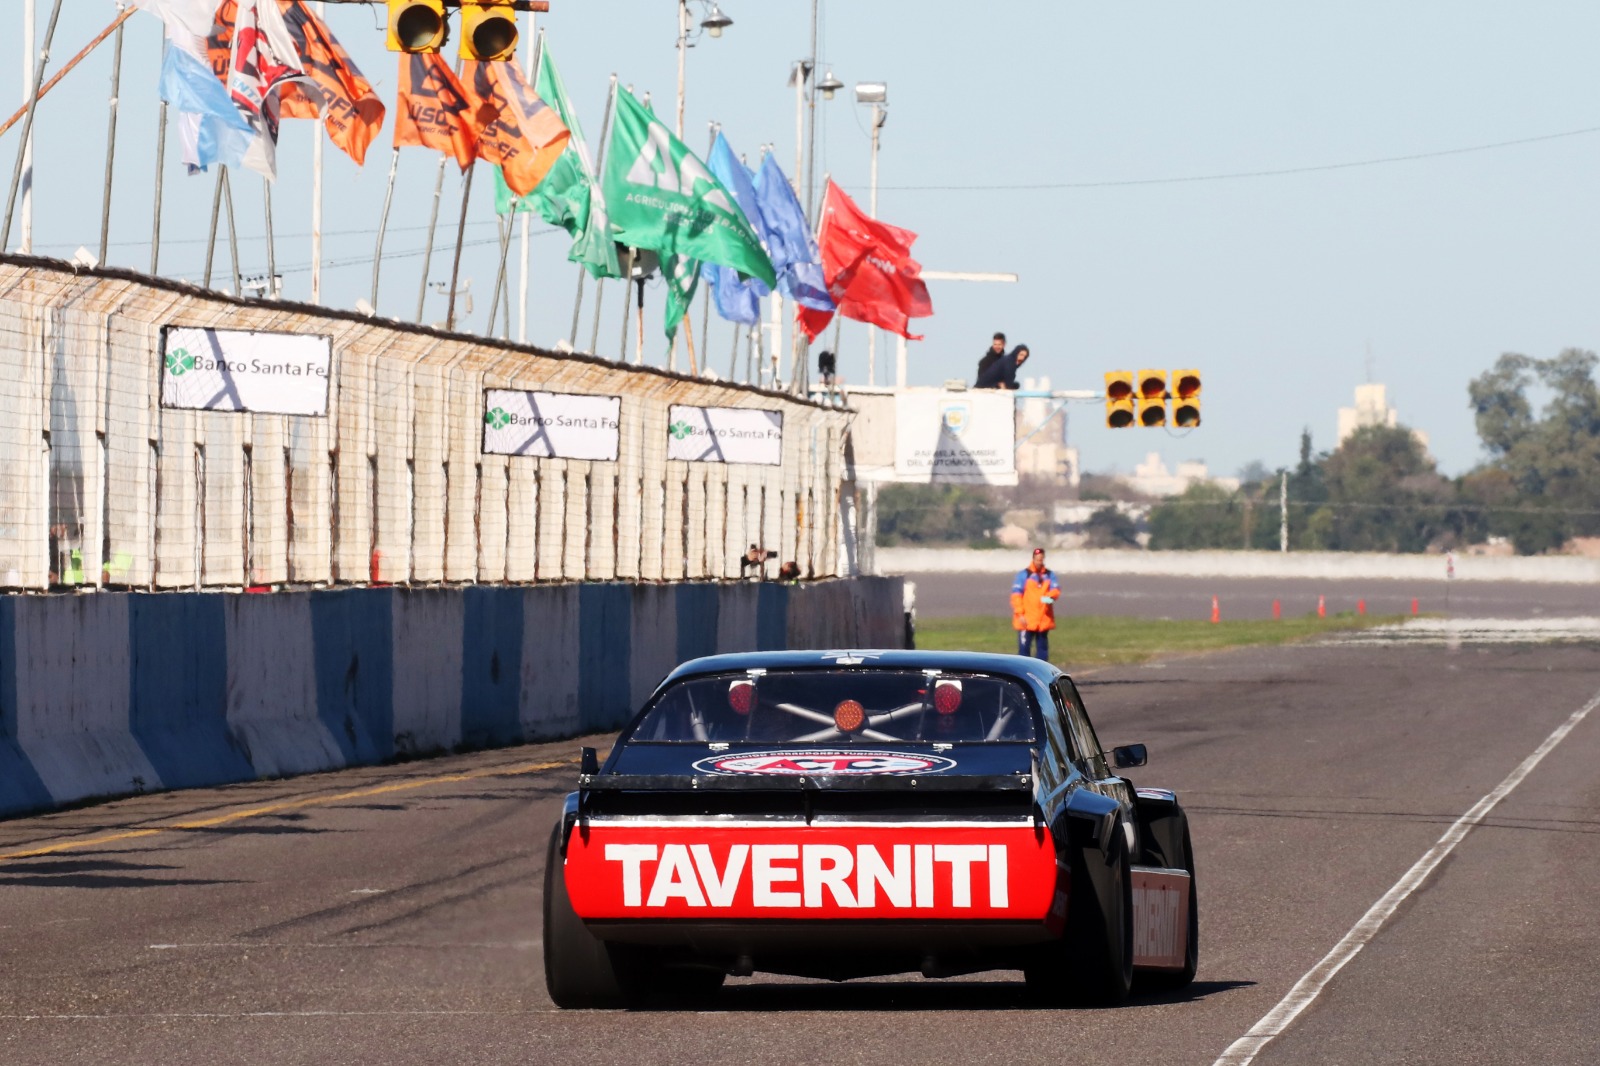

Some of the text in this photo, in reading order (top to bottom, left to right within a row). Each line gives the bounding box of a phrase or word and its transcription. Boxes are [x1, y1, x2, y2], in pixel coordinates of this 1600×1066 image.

[193, 355, 325, 377] Banco Santa Fe
[510, 412, 618, 429] Banco Santa Fe
[690, 425, 781, 440] Banco Santa Fe
[751, 758, 889, 771] ACTC
[604, 843, 1009, 909] TAVERNITI
